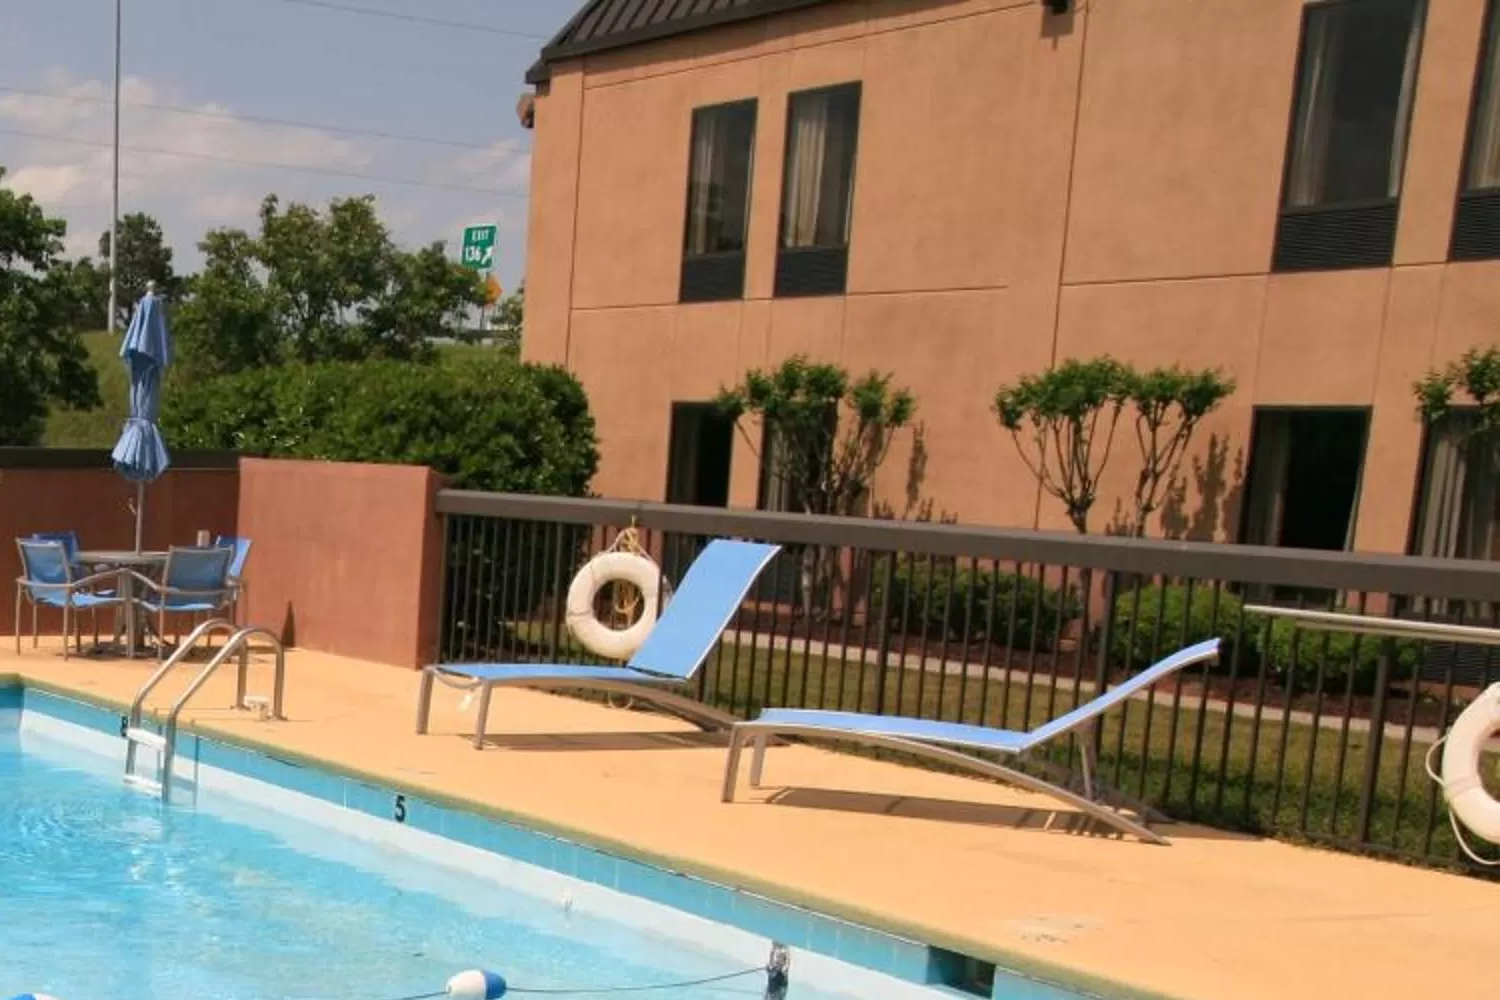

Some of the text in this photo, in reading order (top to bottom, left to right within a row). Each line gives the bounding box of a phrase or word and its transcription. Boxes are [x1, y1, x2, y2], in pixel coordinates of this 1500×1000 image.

[472, 230, 489, 241] EXIT
[465, 246, 481, 261] 136
[395, 795, 406, 823] 5
